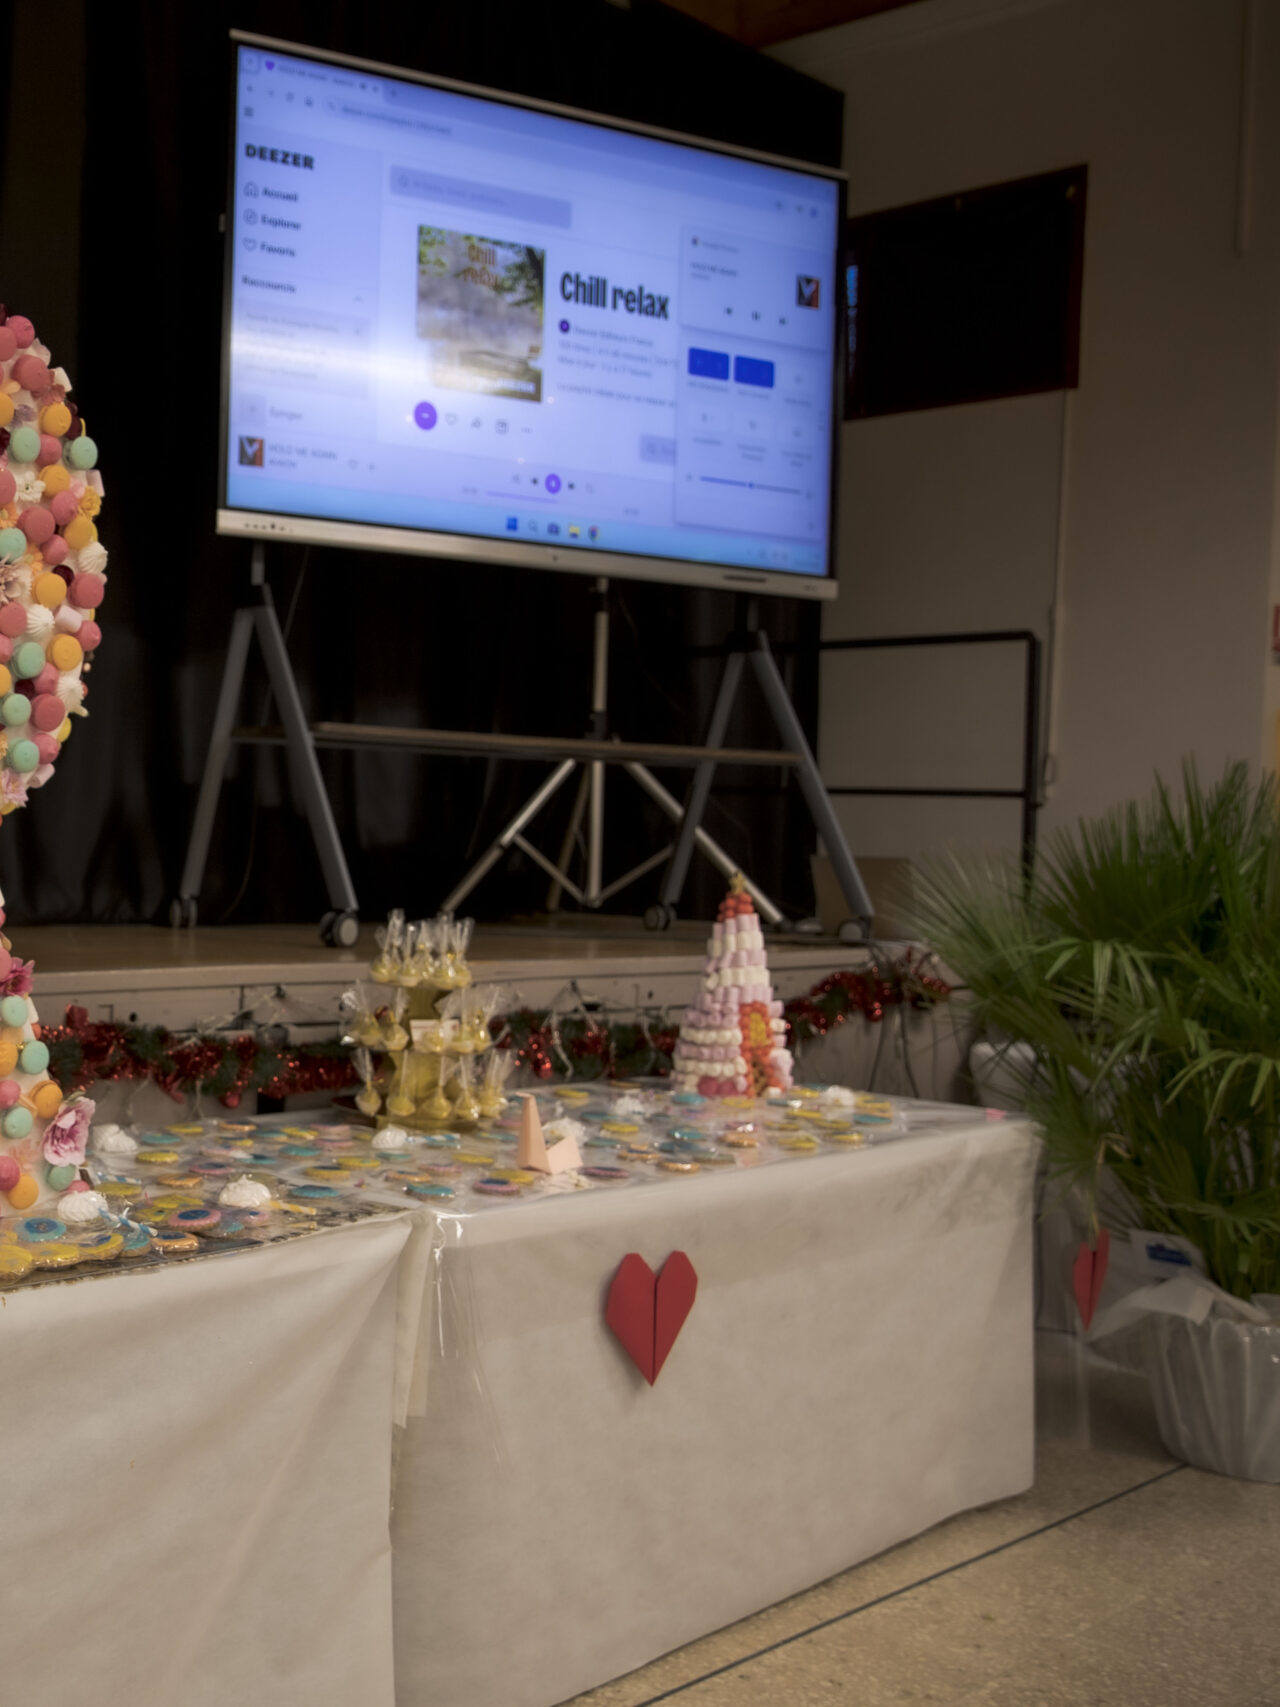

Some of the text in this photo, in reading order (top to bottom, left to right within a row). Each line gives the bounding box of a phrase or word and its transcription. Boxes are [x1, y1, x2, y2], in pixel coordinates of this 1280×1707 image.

[244, 143, 315, 171] DEEZER
[261, 213, 302, 231] Explorer
[261, 241, 296, 258] Favoris
[560, 271, 670, 320] Chill relax
